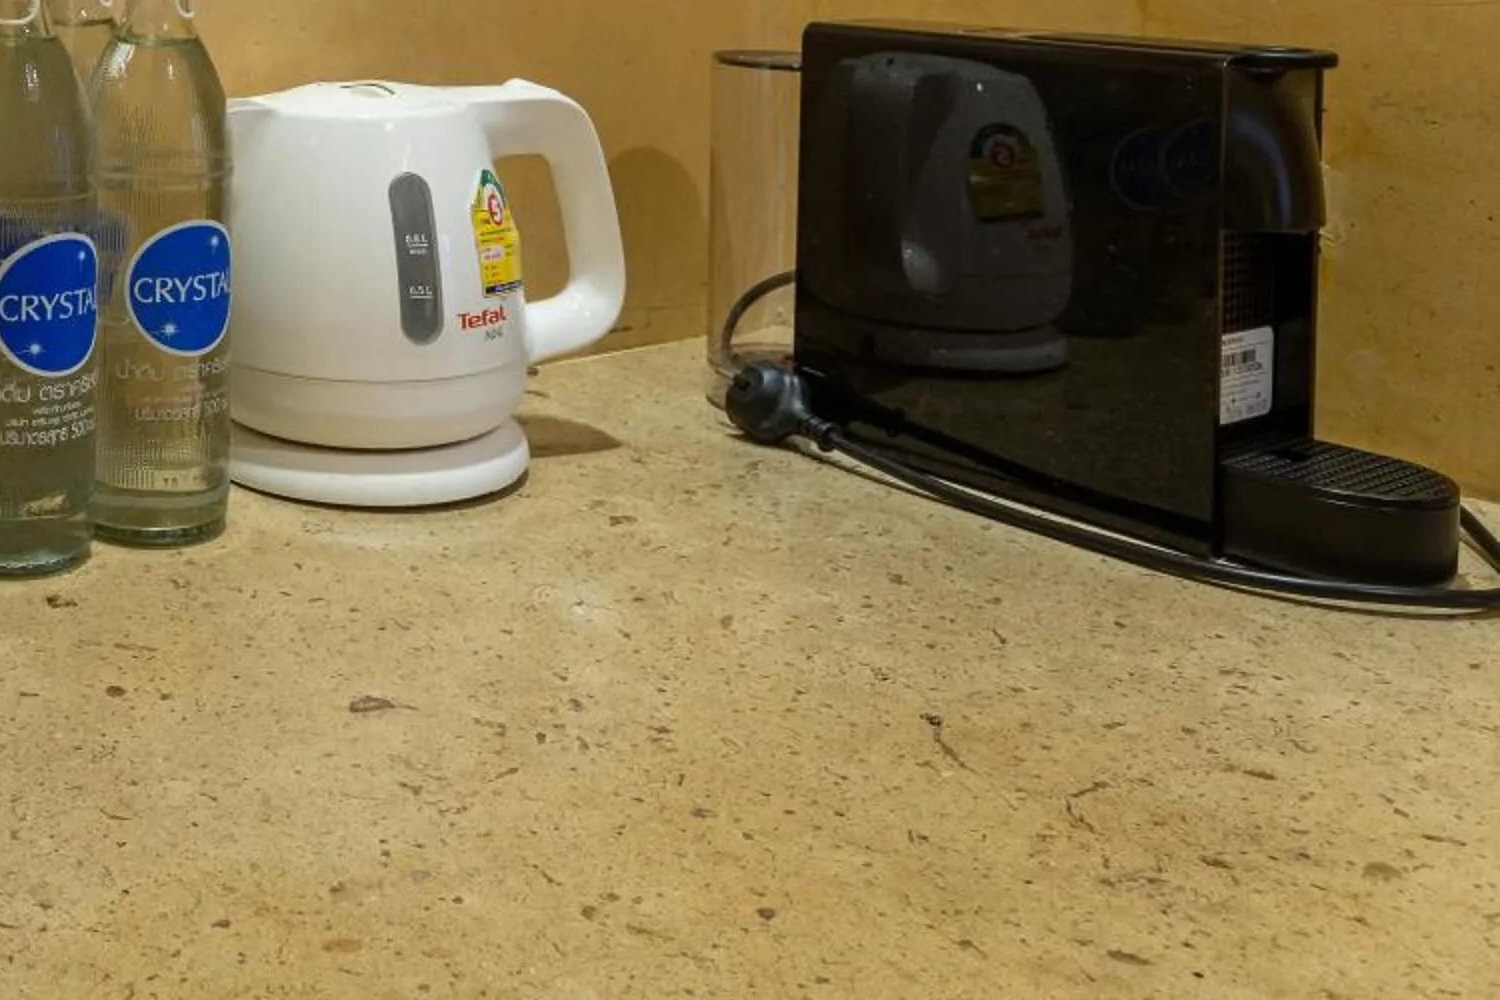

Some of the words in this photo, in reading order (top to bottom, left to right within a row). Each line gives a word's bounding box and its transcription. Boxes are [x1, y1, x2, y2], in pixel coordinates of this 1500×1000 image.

[133, 271, 232, 303] CRYSTA
[0, 288, 97, 322] CRYSTA
[457, 304, 507, 330] Tefal
